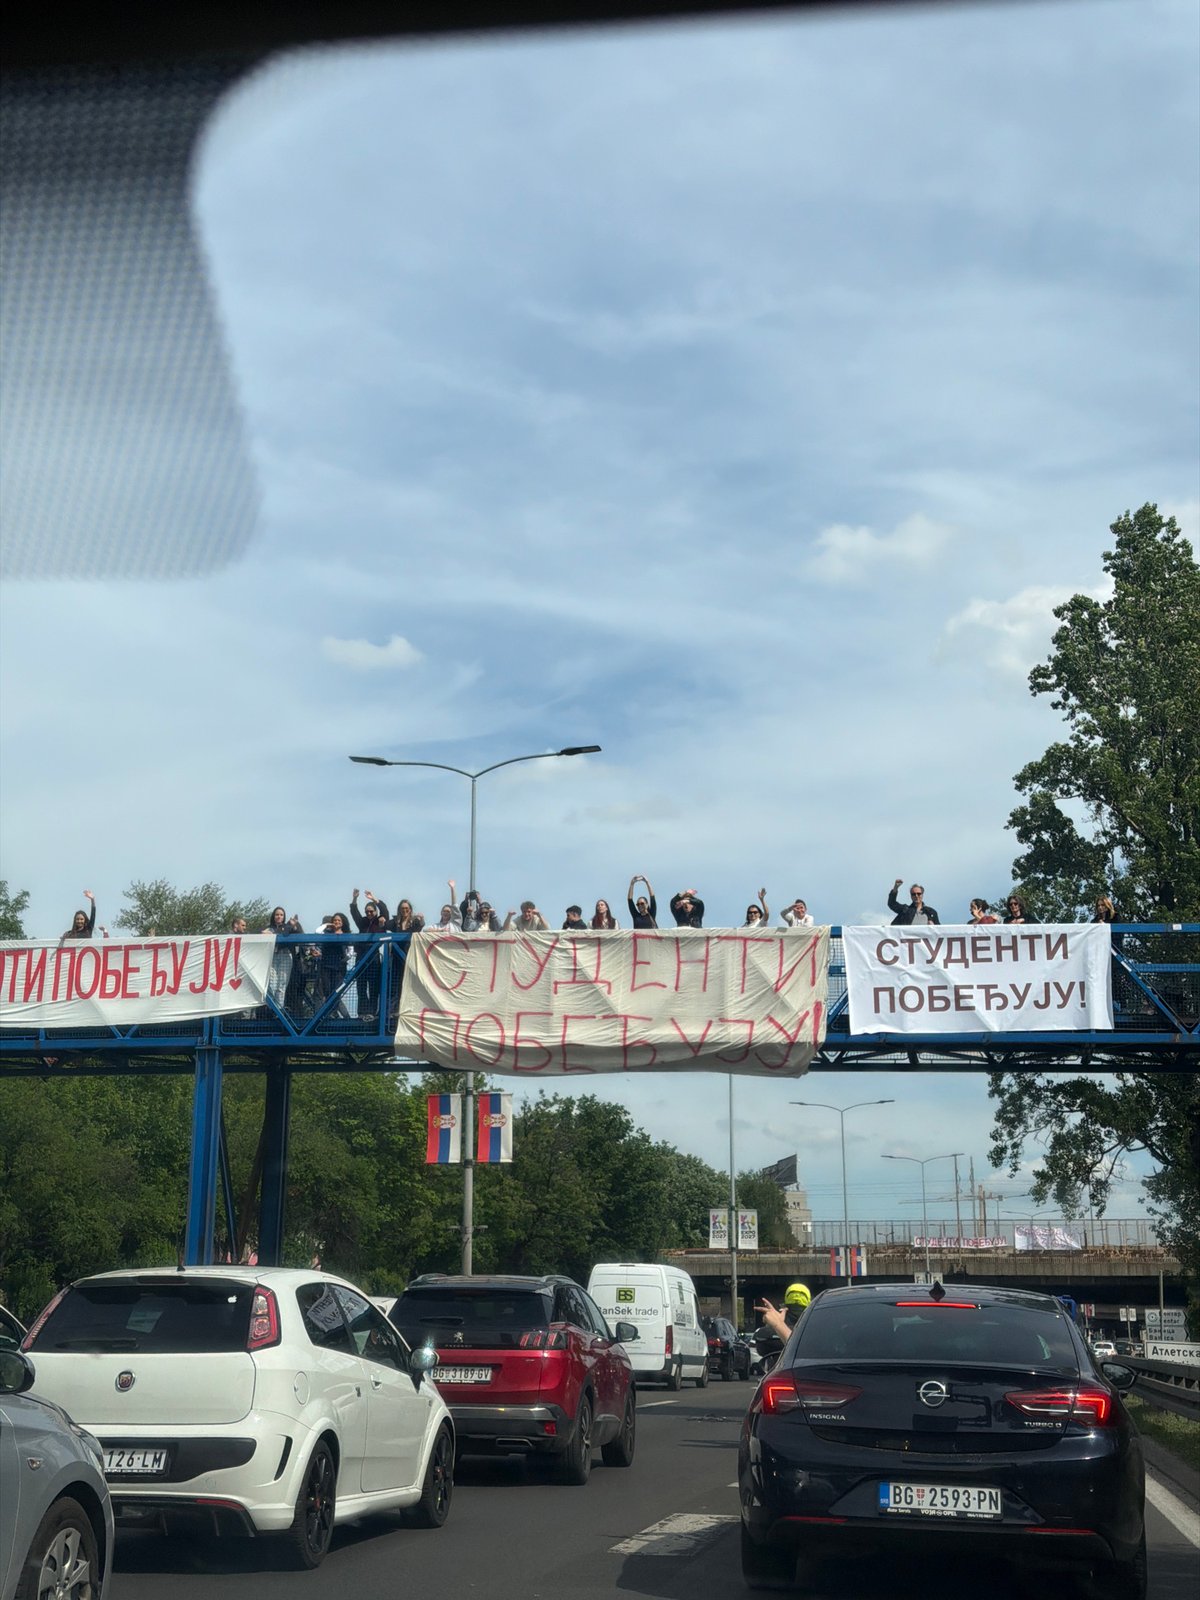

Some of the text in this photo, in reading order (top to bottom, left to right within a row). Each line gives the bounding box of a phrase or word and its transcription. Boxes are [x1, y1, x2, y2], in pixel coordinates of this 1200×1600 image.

[876, 933, 1068, 969] СТУДЕНТИ
[52, 937, 243, 1001] ПОБЕЂУЈУ!
[425, 933, 820, 996] СТУДЕНТИ
[873, 981, 1086, 1014] ПОБЕЂУЈУ!
[420, 1001, 823, 1072] ПОБЕЂУЈУ!
[618, 1289, 633, 1301] BS
[635, 1307, 659, 1316] trade
[432, 1368, 444, 1379] BG
[809, 1413, 846, 1421] INSIGNIA
[893, 1486, 913, 1505] BG
